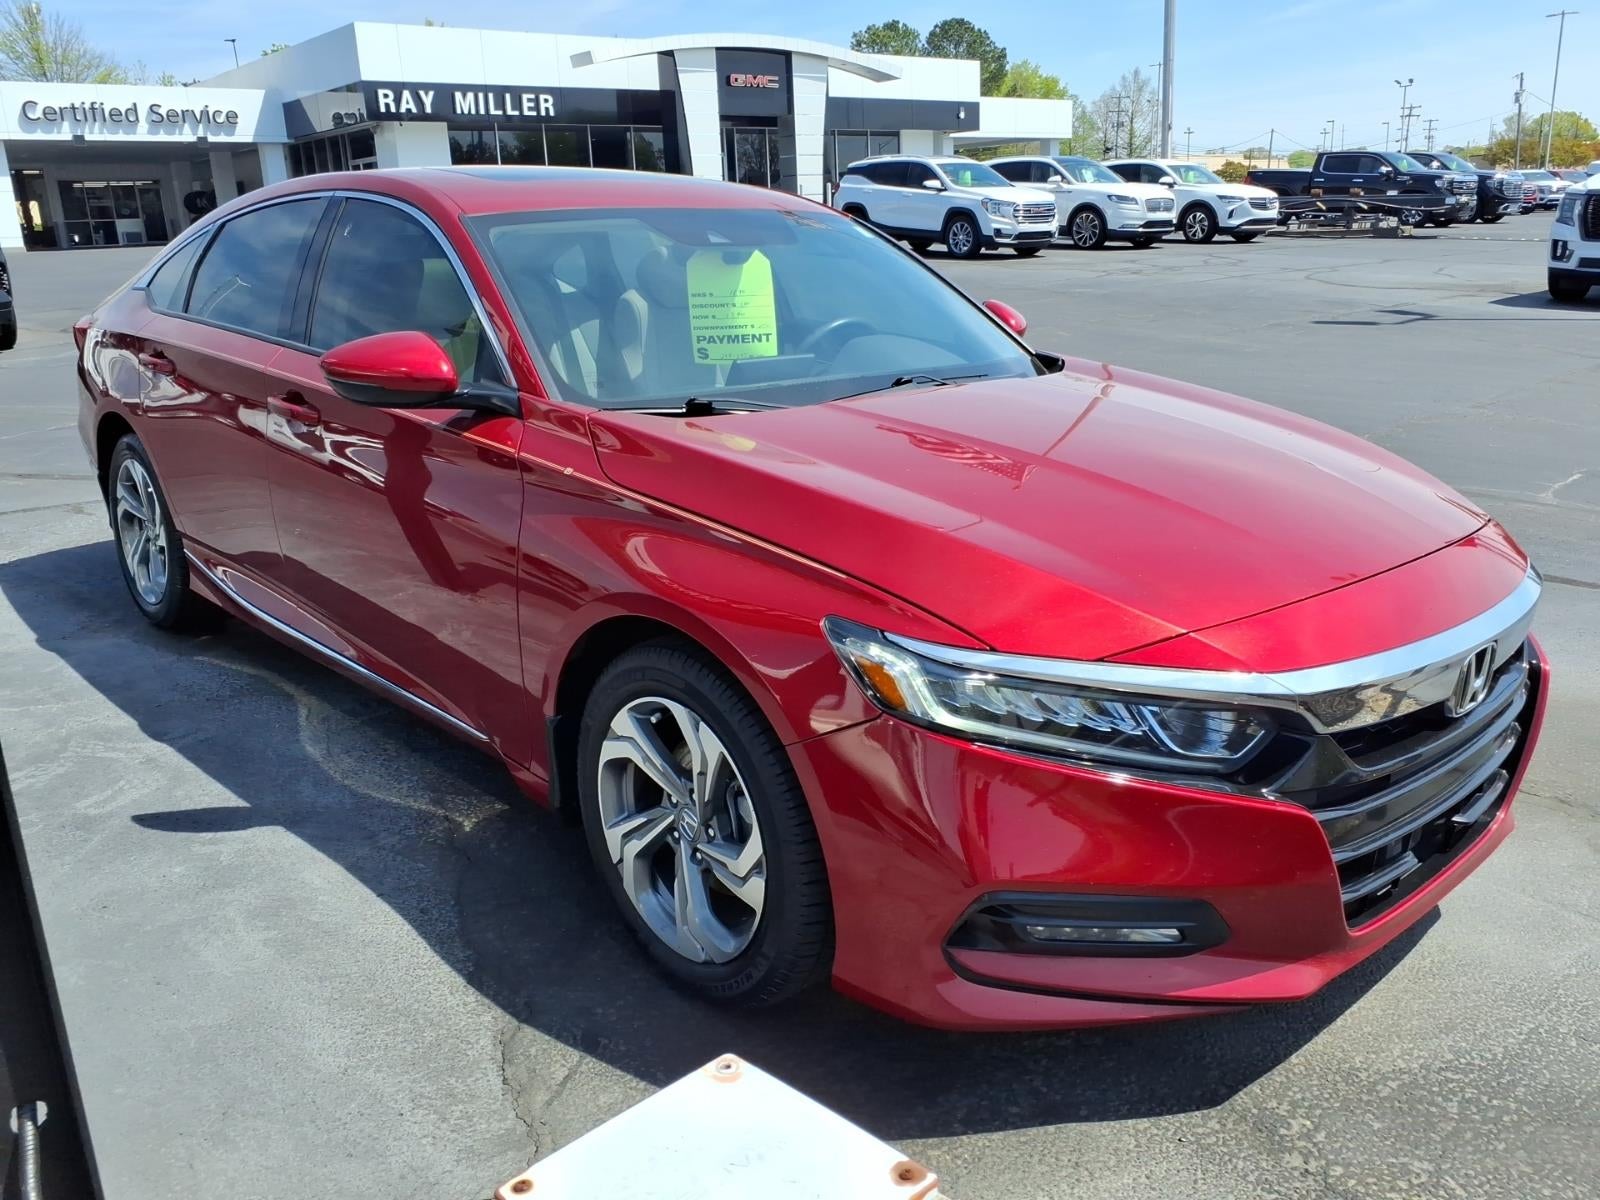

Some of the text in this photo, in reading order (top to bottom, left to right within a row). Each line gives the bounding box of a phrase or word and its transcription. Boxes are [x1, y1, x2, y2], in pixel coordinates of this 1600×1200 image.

[730, 74, 779, 88] GMC
[376, 88, 556, 117] RAY MILLER
[21, 100, 239, 126] Certified Service
[696, 333, 772, 345] PAYMENT
[697, 347, 710, 361] $
